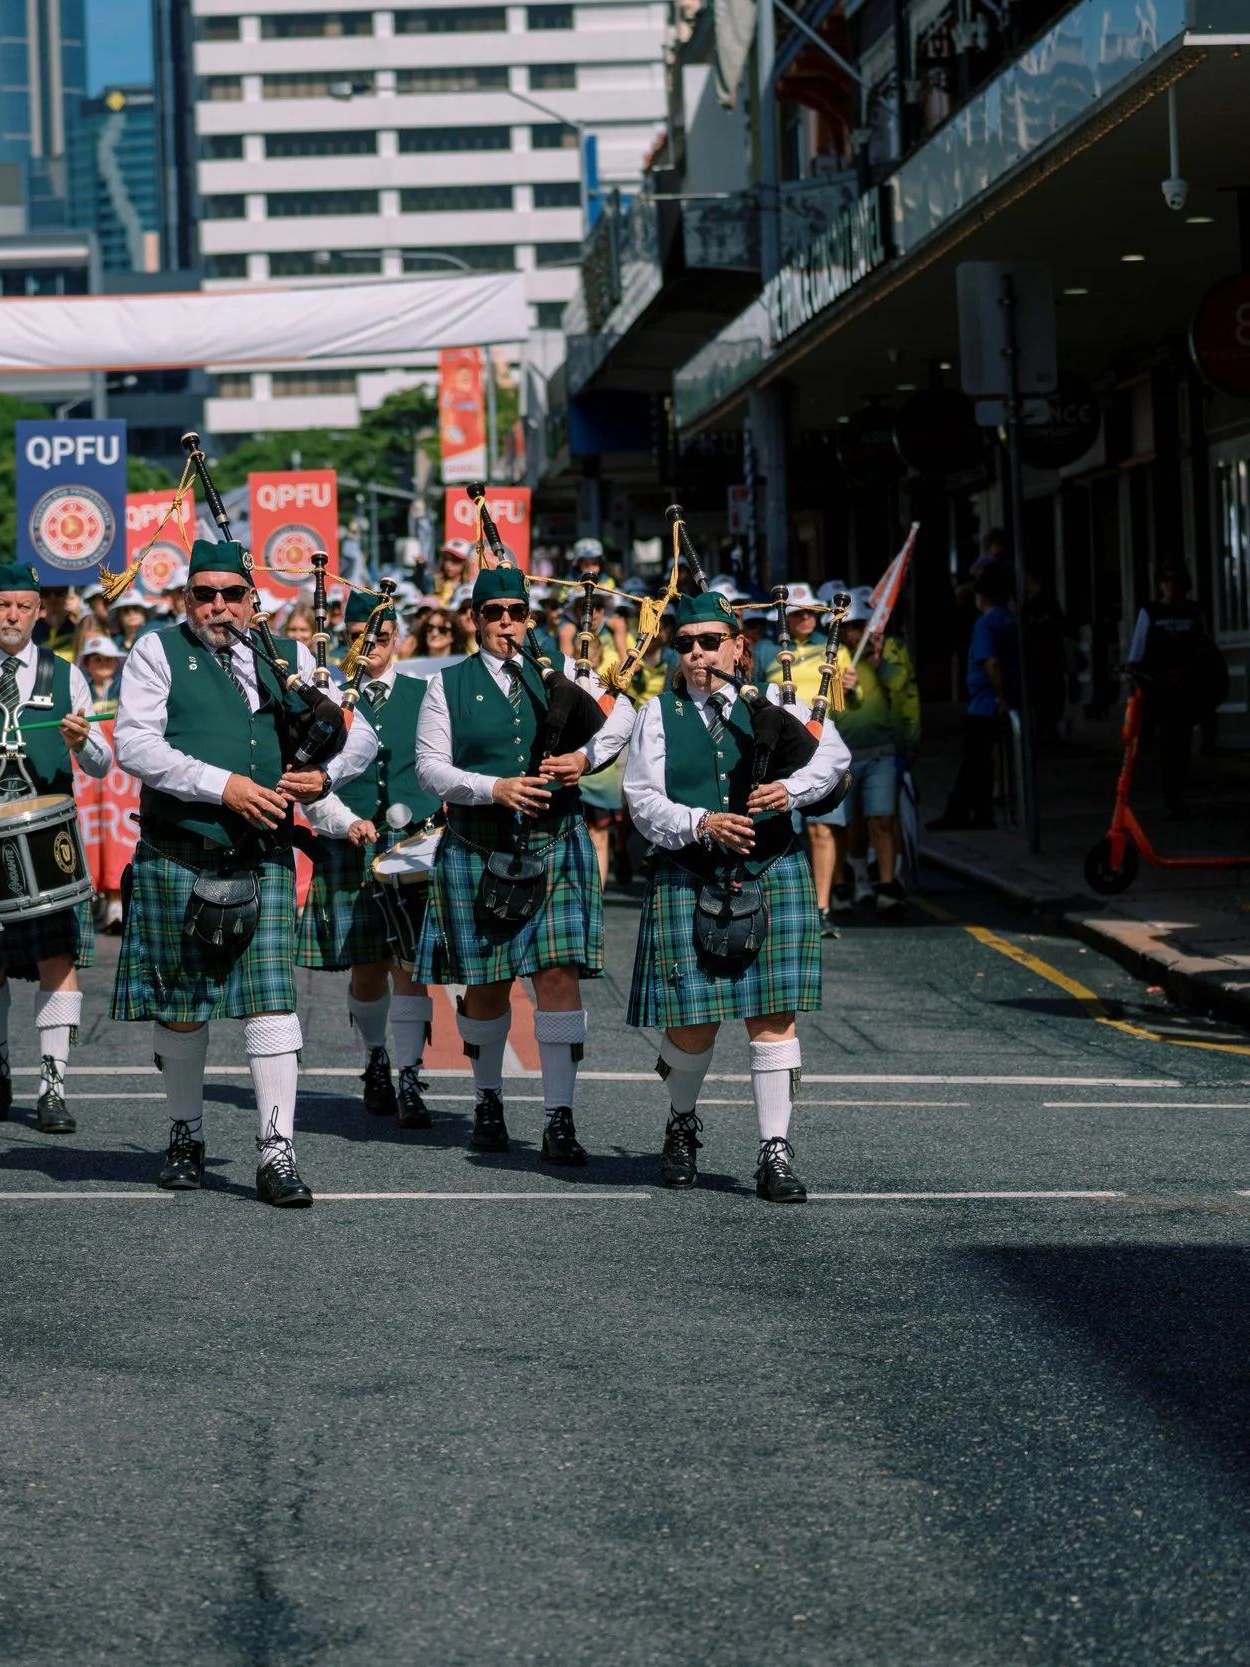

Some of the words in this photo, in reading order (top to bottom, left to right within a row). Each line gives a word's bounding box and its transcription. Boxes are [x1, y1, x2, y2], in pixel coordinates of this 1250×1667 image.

[26, 435, 120, 470] QPFU
[257, 483, 331, 512] QPFU
[126, 502, 191, 531] QPFU
